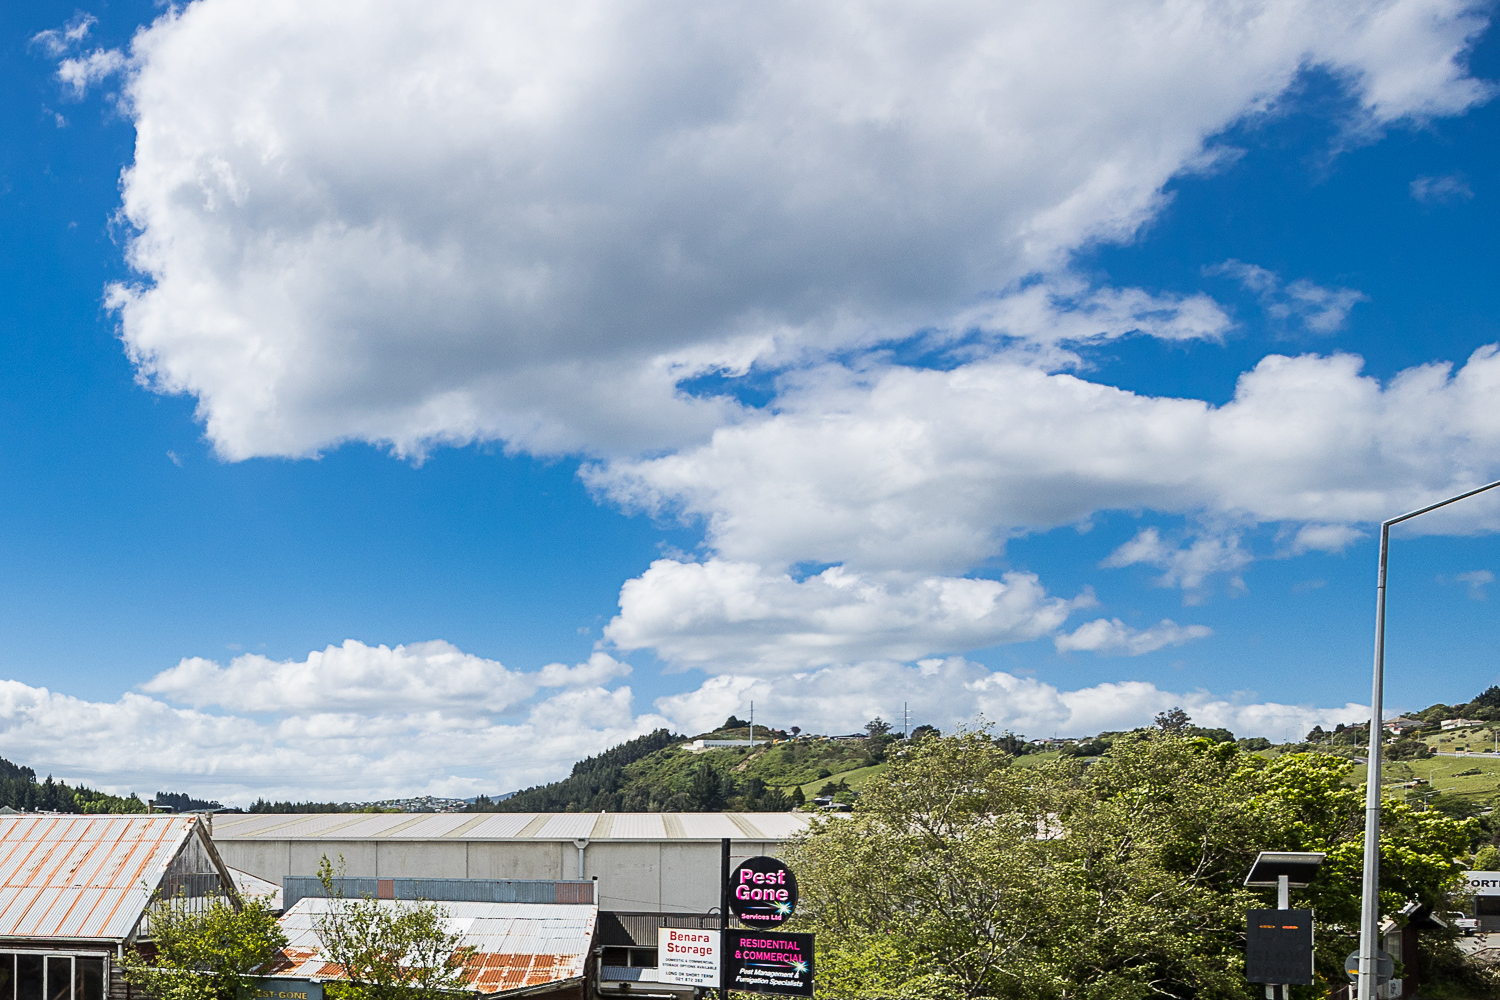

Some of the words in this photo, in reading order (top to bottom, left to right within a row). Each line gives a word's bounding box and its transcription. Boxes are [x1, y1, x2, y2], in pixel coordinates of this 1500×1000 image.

[740, 869, 785, 884] Pest
[736, 885, 789, 900] Gone
[670, 931, 710, 942] Benara
[667, 943, 713, 956] Storage
[740, 938, 800, 950] RESIDENTIAL
[734, 950, 742, 959] &
[743, 951, 805, 963] COMMERCIAL
[754, 969, 794, 978] Management
[735, 975, 769, 985] Fumigation
[769, 978, 803, 987] Specialists
